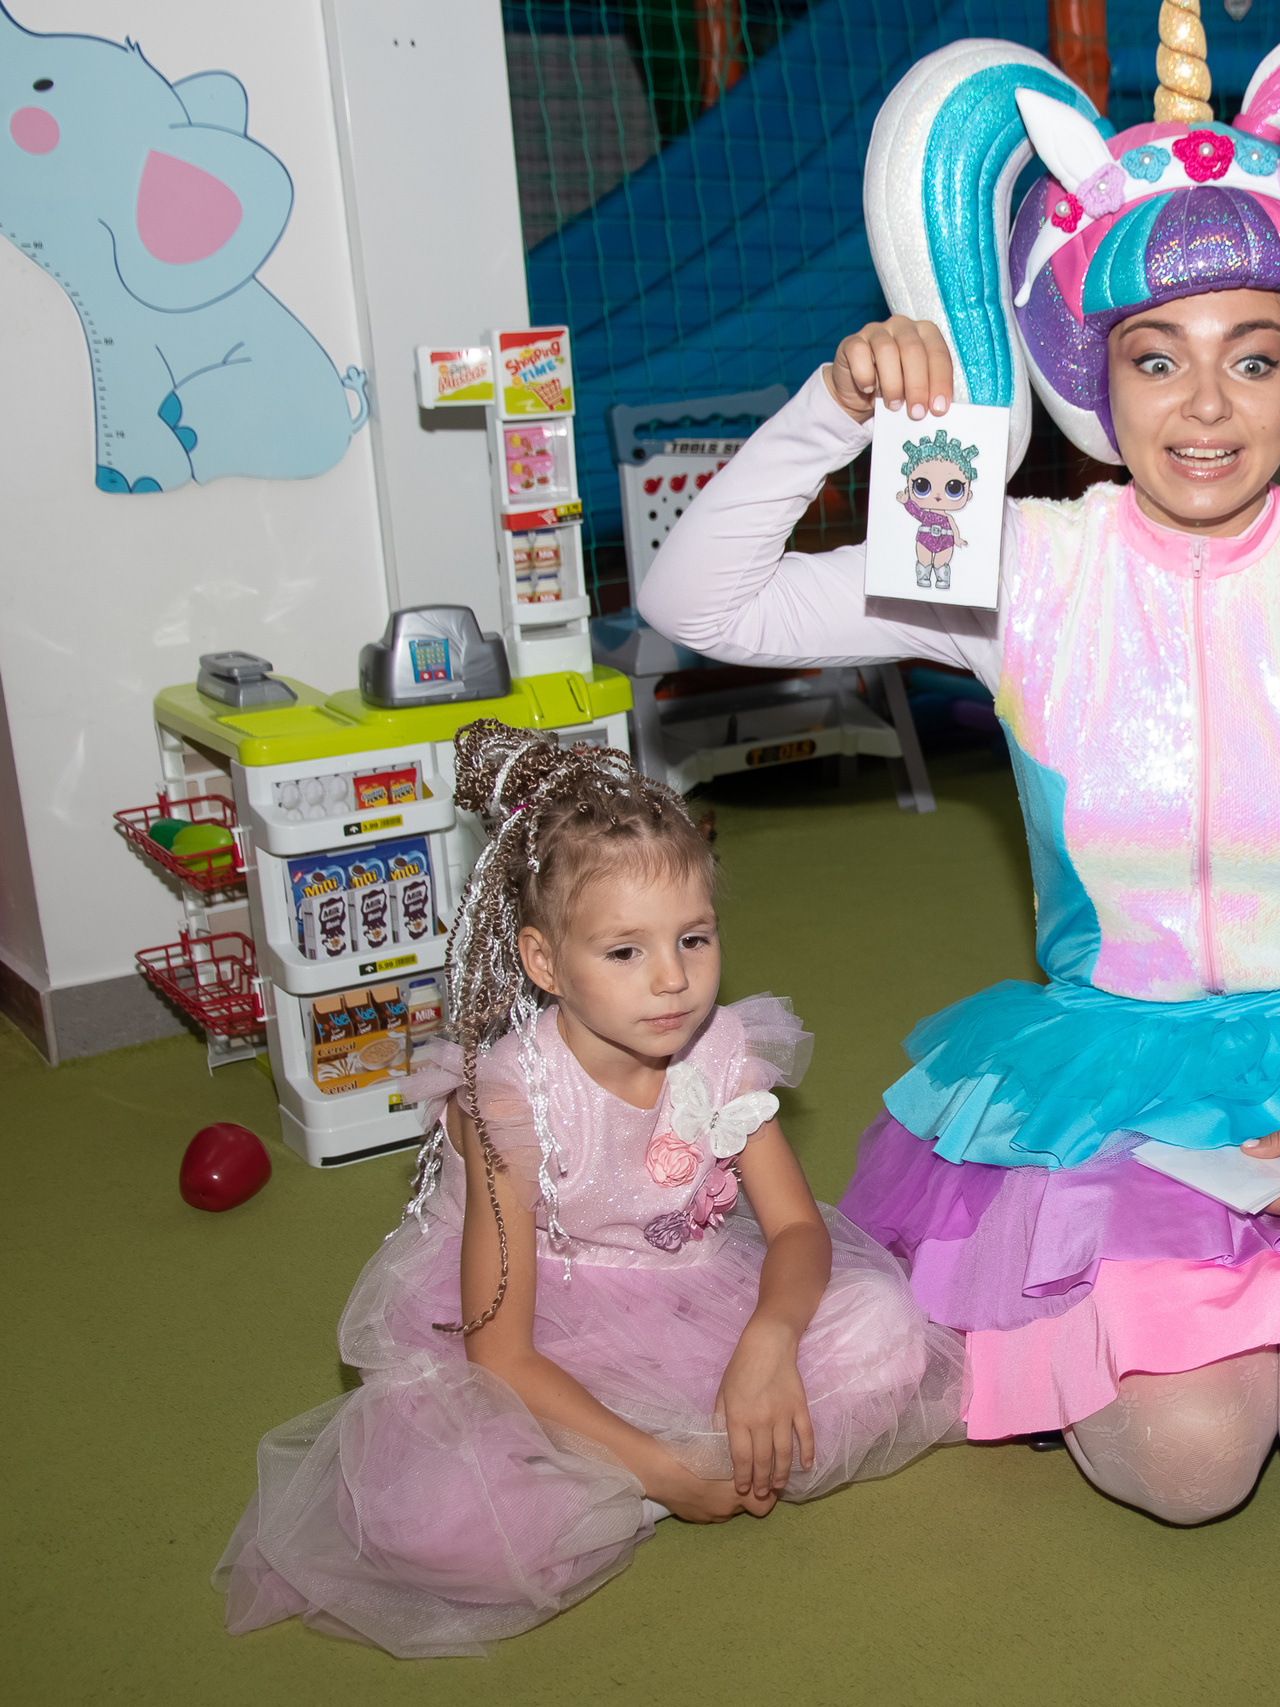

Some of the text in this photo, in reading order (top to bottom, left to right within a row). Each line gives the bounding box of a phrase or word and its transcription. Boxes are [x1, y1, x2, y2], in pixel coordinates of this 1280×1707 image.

[505, 340, 560, 376] Shopping
[518, 359, 556, 384] TIME
[672, 442, 717, 454] TOOLS
[415, 1008, 436, 1021] Milk
[318, 1041, 355, 1057] Cereal
